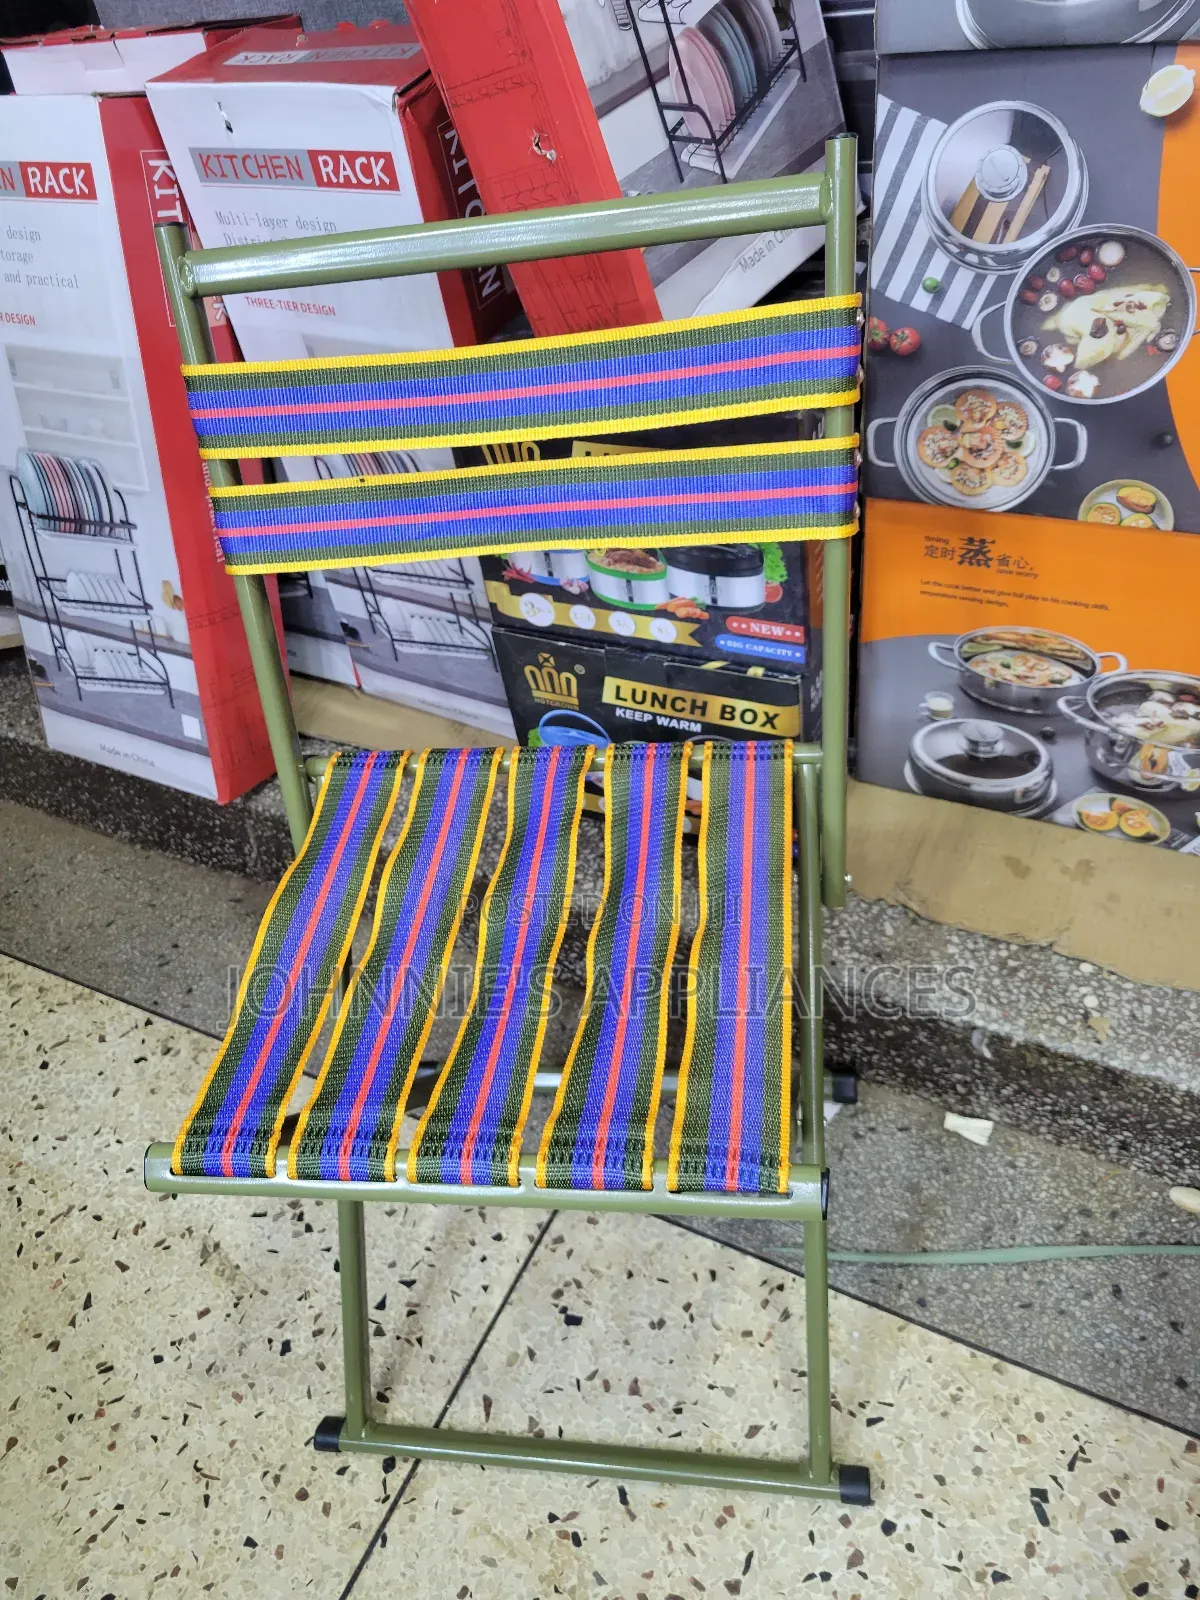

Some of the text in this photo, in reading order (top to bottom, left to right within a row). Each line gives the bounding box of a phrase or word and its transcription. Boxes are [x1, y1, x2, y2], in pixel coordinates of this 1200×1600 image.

[236, 53, 295, 64] RACK
[198, 152, 391, 186] KITCHEN RACK
[27, 166, 89, 195] RACK
[215, 211, 338, 233] Multi-layer design
[6, 225, 42, 243] design
[739, 243, 768, 274] Made
[764, 239, 777, 255] in
[4, 270, 80, 289] and practical
[300, 300, 337, 316] DESIGN
[5, 312, 36, 326] DESIGN
[749, 622, 786, 637] NEW
[726, 639, 793, 657] BIG CAPACITY
[615, 685, 780, 730] LUNCH BOX
[615, 707, 702, 733] KEEP WARM
